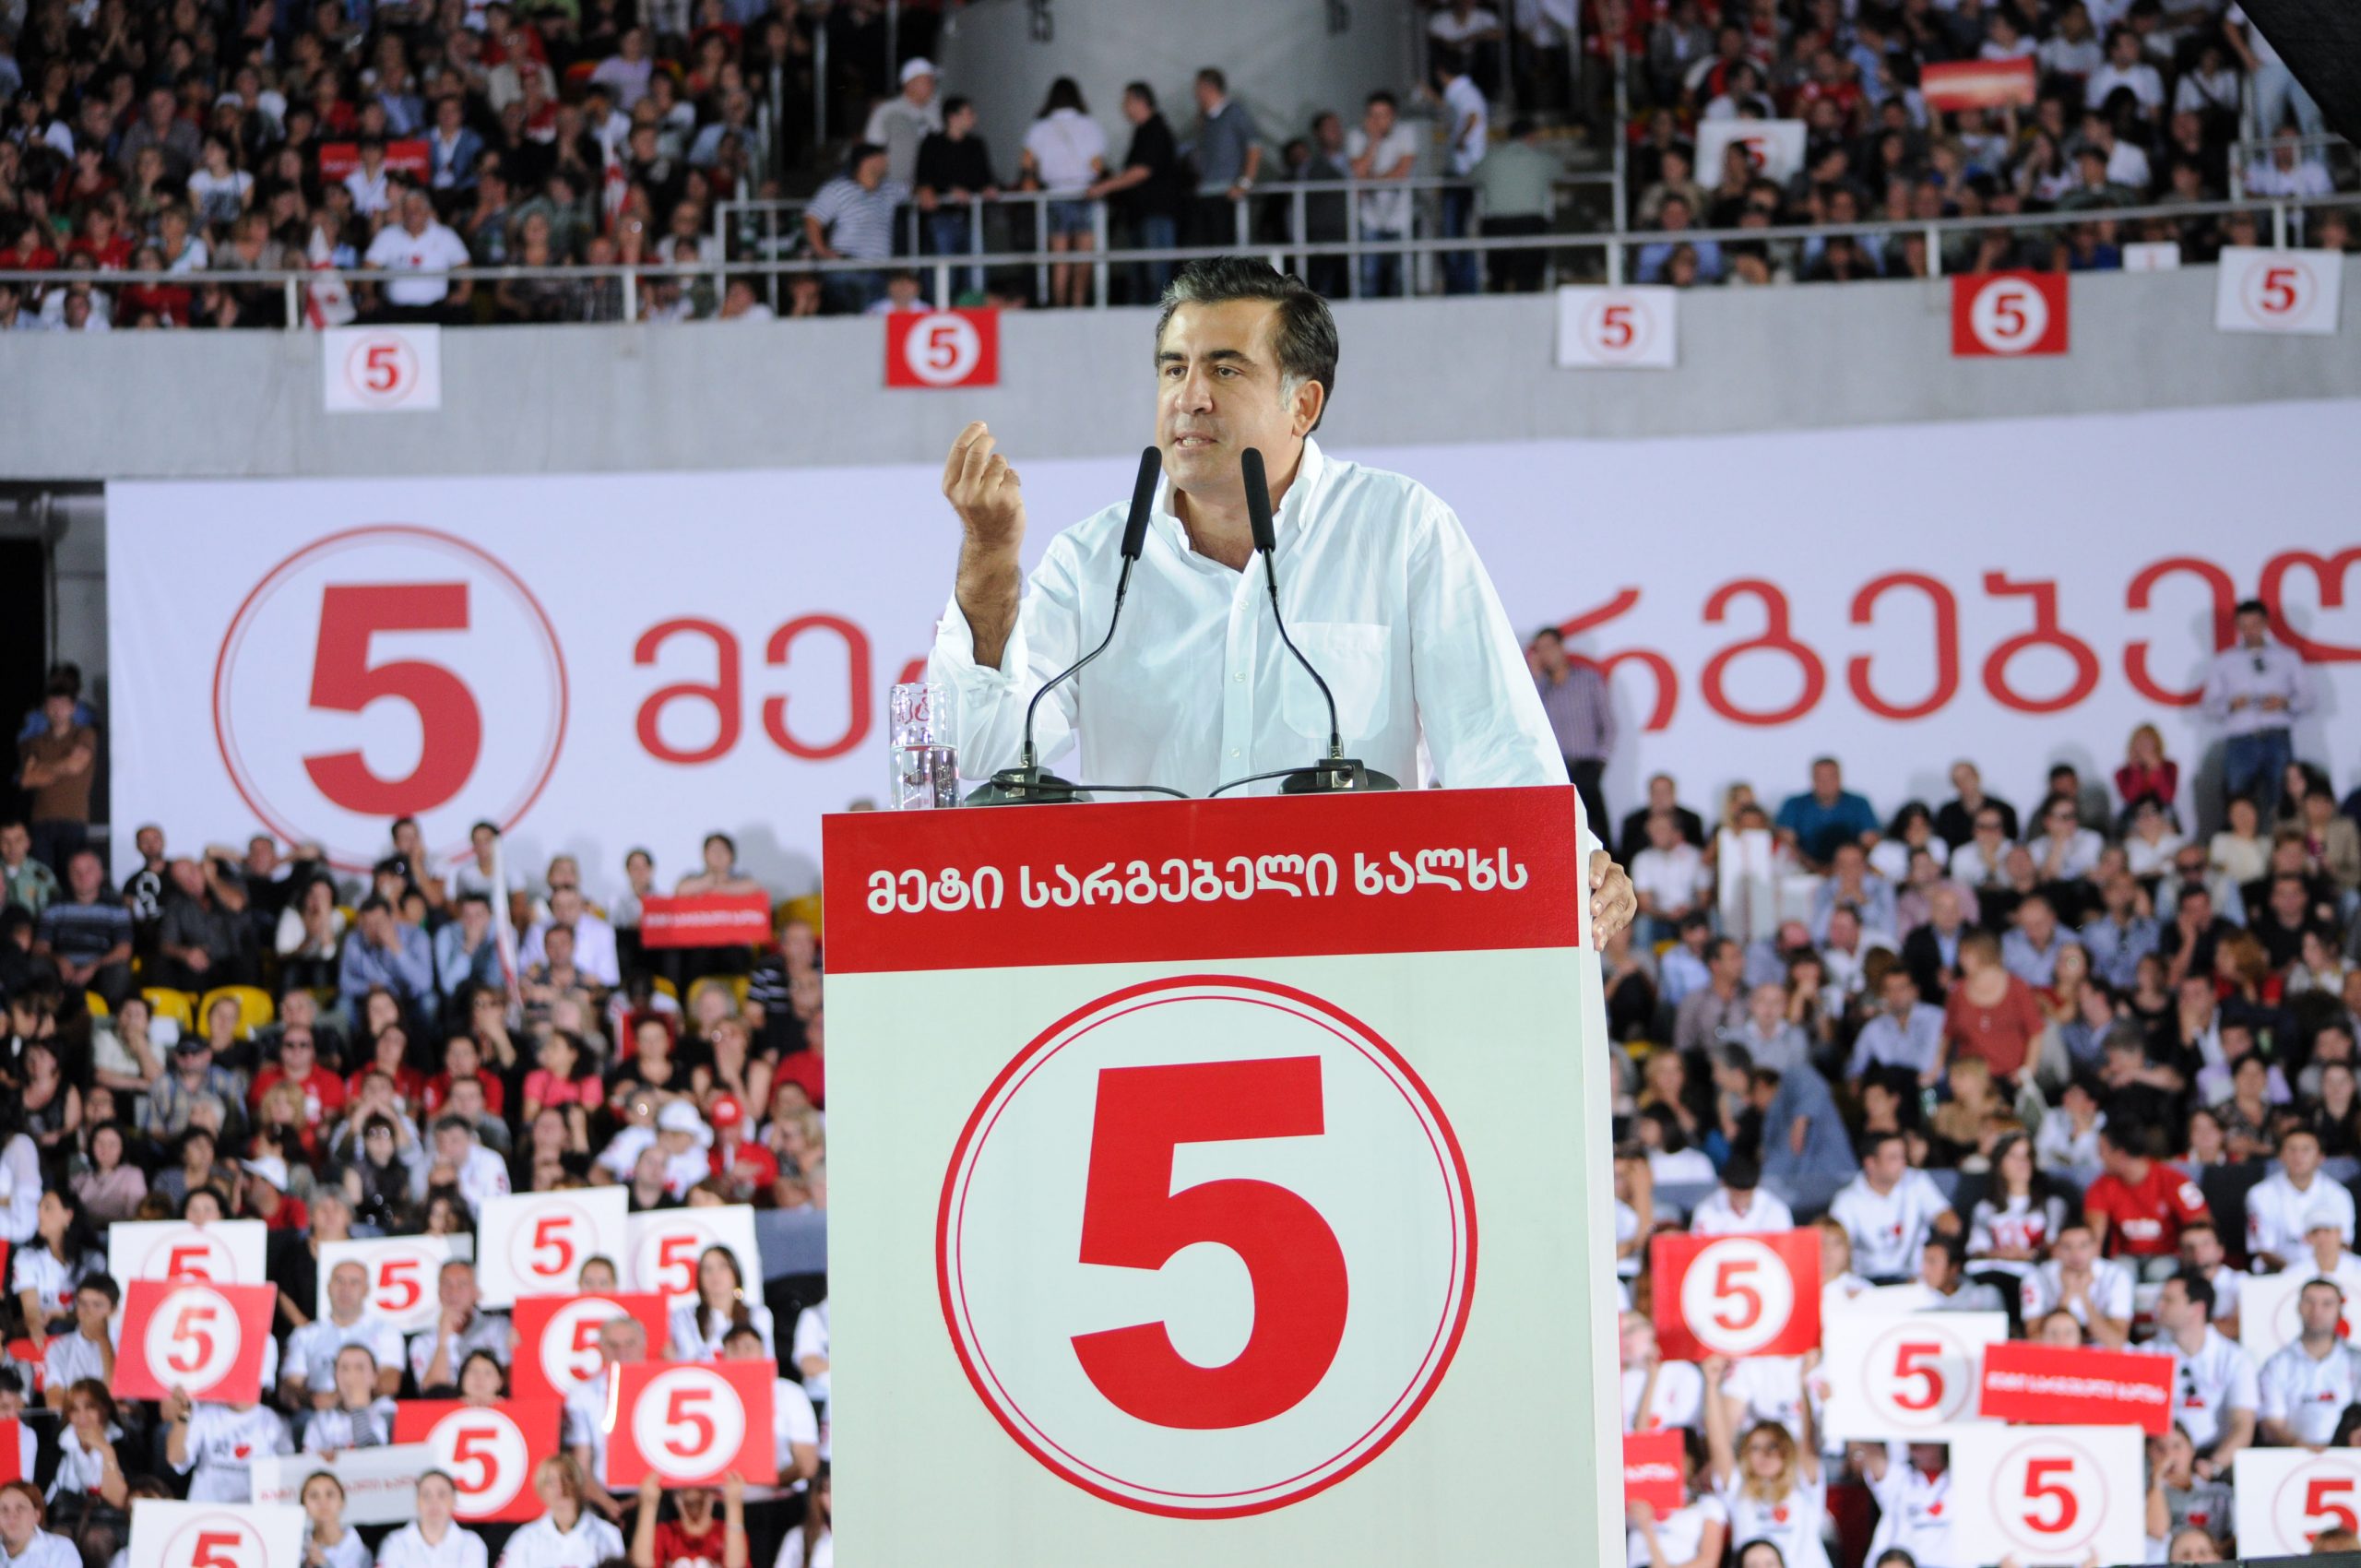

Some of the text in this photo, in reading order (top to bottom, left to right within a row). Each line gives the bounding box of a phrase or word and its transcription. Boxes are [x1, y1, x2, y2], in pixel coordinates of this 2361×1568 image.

[1996, 294, 2027, 338] 5
[2264, 269, 2296, 313] 5
[929, 327, 960, 370] 5
[1603, 306, 1634, 348] 5
[366, 347, 399, 392] 5
[303, 583, 481, 820] 5
[634, 614, 926, 765] მე
[867, 847, 1529, 915] მეტი სარგებელი ხალხს
[531, 1216, 575, 1278] 5
[658, 1235, 700, 1295] 5
[1070, 1055, 1350, 1431] 5
[376, 1260, 422, 1313] 5
[1714, 1261, 1762, 1331] 5
[168, 1307, 217, 1373] 5
[569, 1318, 606, 1382] 5
[1892, 1343, 1946, 1412] 5
[664, 1387, 718, 1459] 5
[451, 1427, 499, 1495] 5
[2022, 1457, 2080, 1535] 5
[2304, 1478, 2360, 1544] 5
